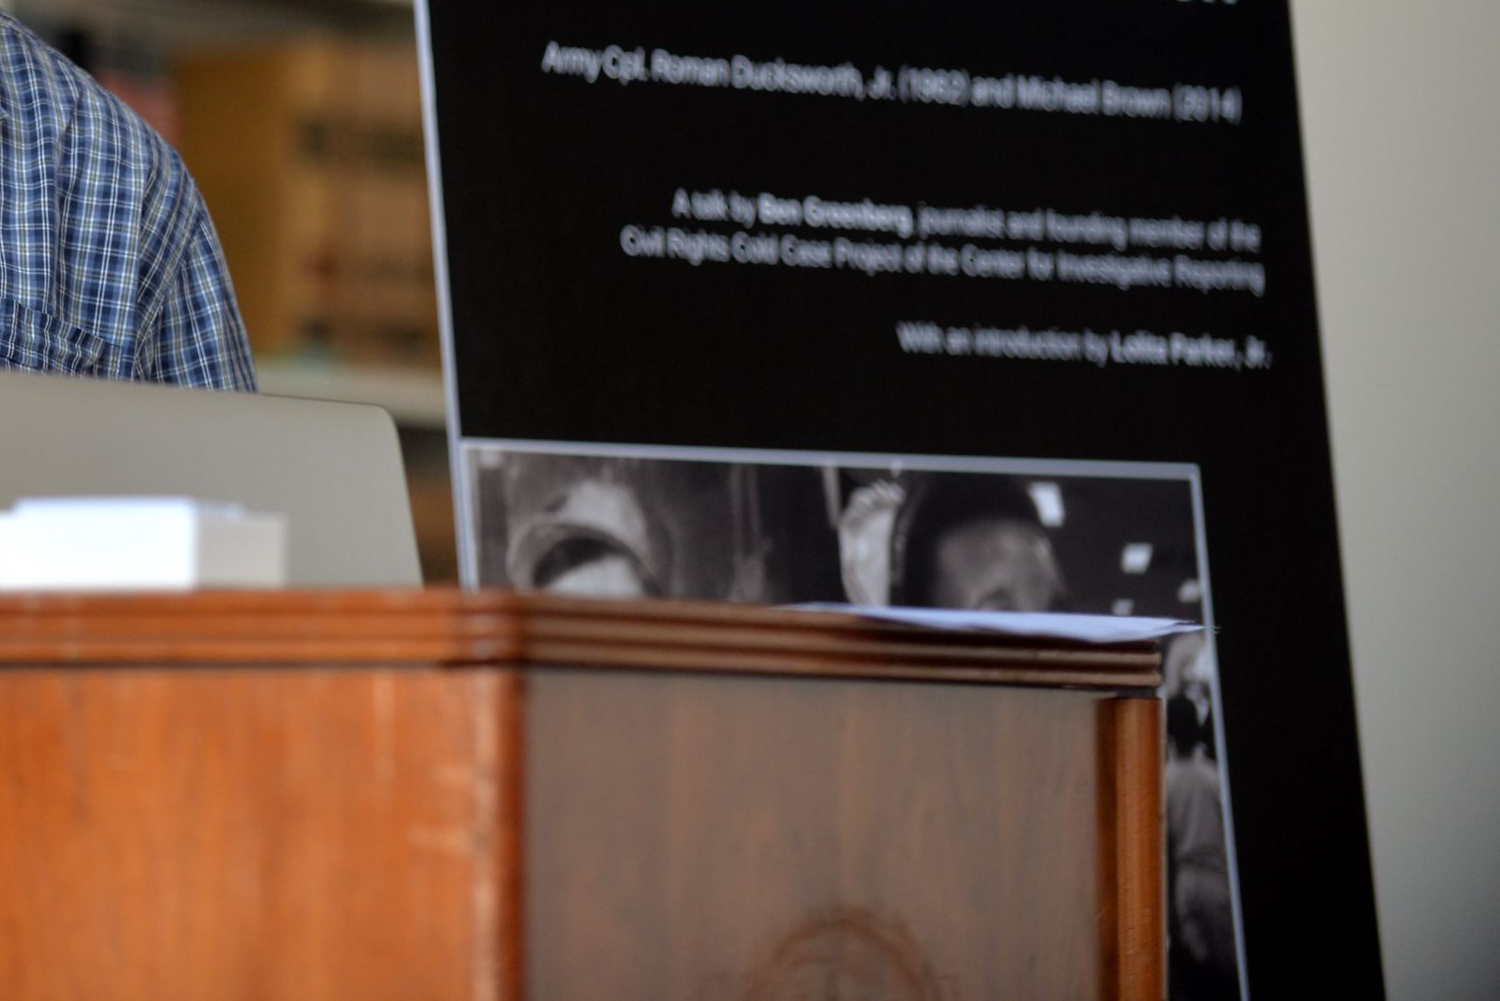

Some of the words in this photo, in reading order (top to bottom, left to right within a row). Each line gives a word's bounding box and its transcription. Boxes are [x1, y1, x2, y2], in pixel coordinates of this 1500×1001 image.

[541, 40, 600, 84] Army
[602, 45, 649, 85] Cpl.
[650, 49, 730, 88] Roman
[971, 73, 1014, 111] and
[1015, 74, 1100, 115] Michael
[1101, 80, 1171, 119] Brown
[1172, 81, 1242, 126] (2014)
[671, 187, 692, 219] A
[691, 189, 729, 221] talk
[729, 191, 756, 229] by
[757, 192, 802, 225] Ben
[917, 201, 1005, 239] journalist
[1006, 207, 1044, 241] and
[1045, 207, 1128, 252] founding
[1128, 215, 1205, 250] member
[1206, 217, 1228, 252] of
[1229, 219, 1262, 253] the
[620, 224, 666, 258] Civil
[667, 227, 730, 266] Rights
[731, 231, 780, 265] Cold
[780, 234, 833, 269] Case
[834, 237, 903, 276] Project
[903, 241, 927, 275] of
[927, 242, 960, 277] the
[960, 244, 1026, 279] Center
[1026, 246, 1055, 281] for
[1055, 249, 1173, 291] Investigative
[1173, 254, 1265, 297] Reporting
[896, 319, 944, 354] With
[945, 326, 973, 356] an
[972, 322, 1083, 361] introduction
[1083, 326, 1109, 368] by
